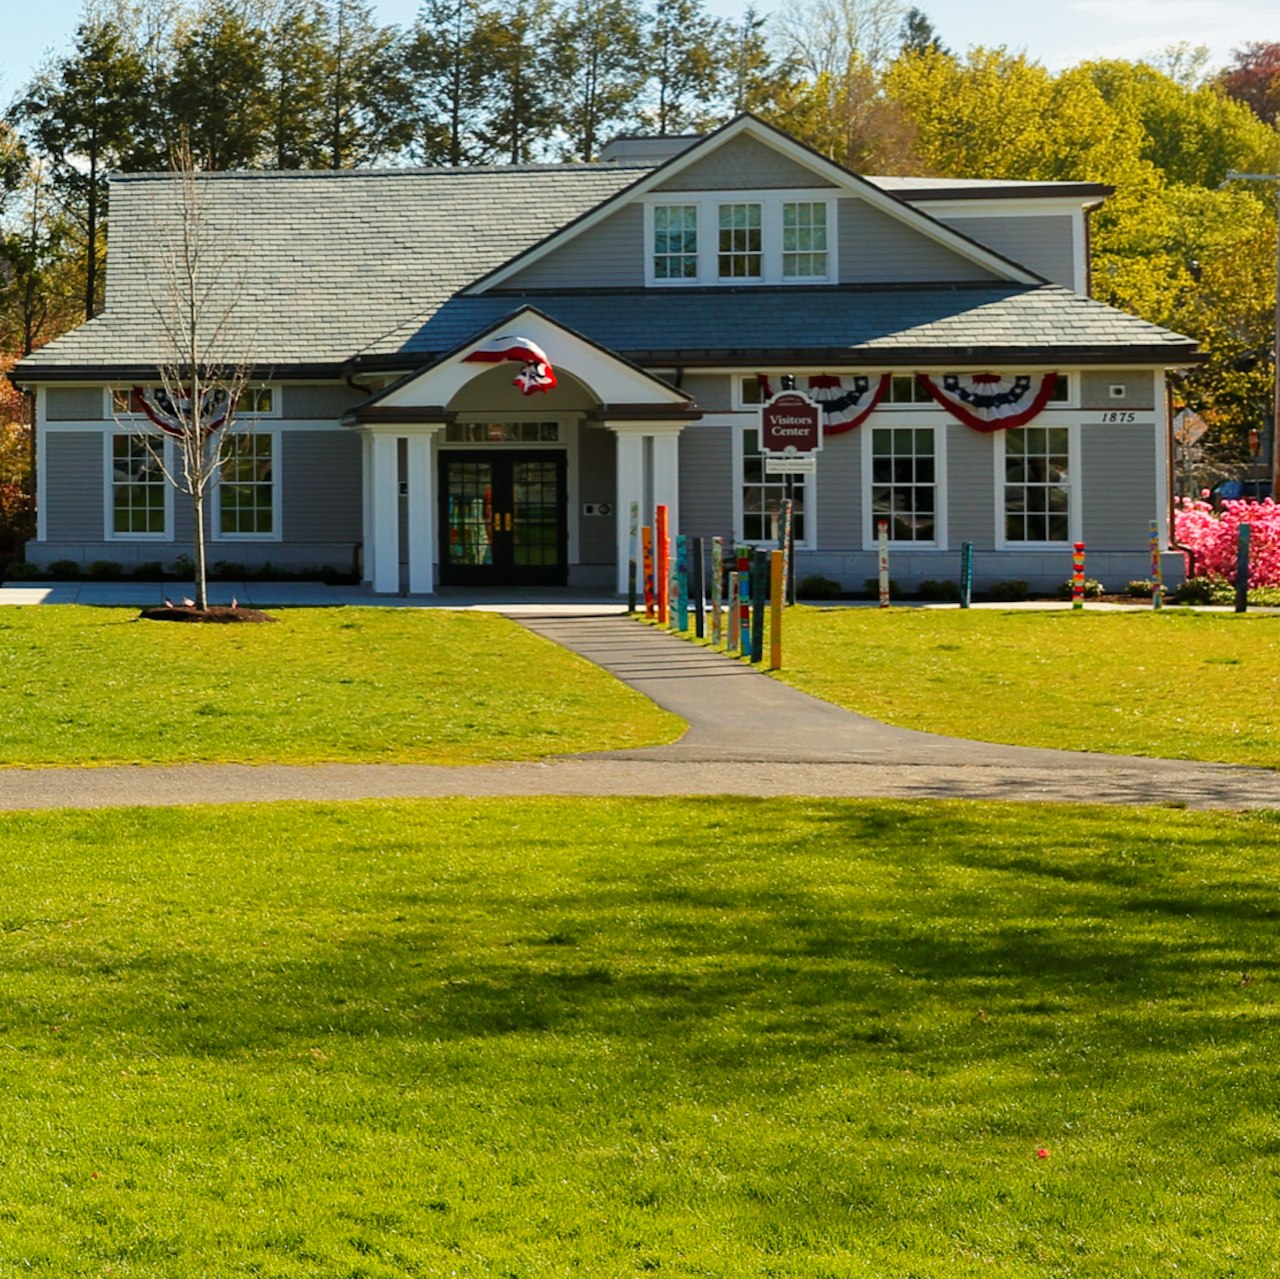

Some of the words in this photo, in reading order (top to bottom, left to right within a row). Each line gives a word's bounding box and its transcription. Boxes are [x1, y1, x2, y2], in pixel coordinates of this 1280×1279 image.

[769, 415, 812, 424] Visitors
[1102, 412, 1135, 422] 1875
[771, 426, 810, 436] Center
